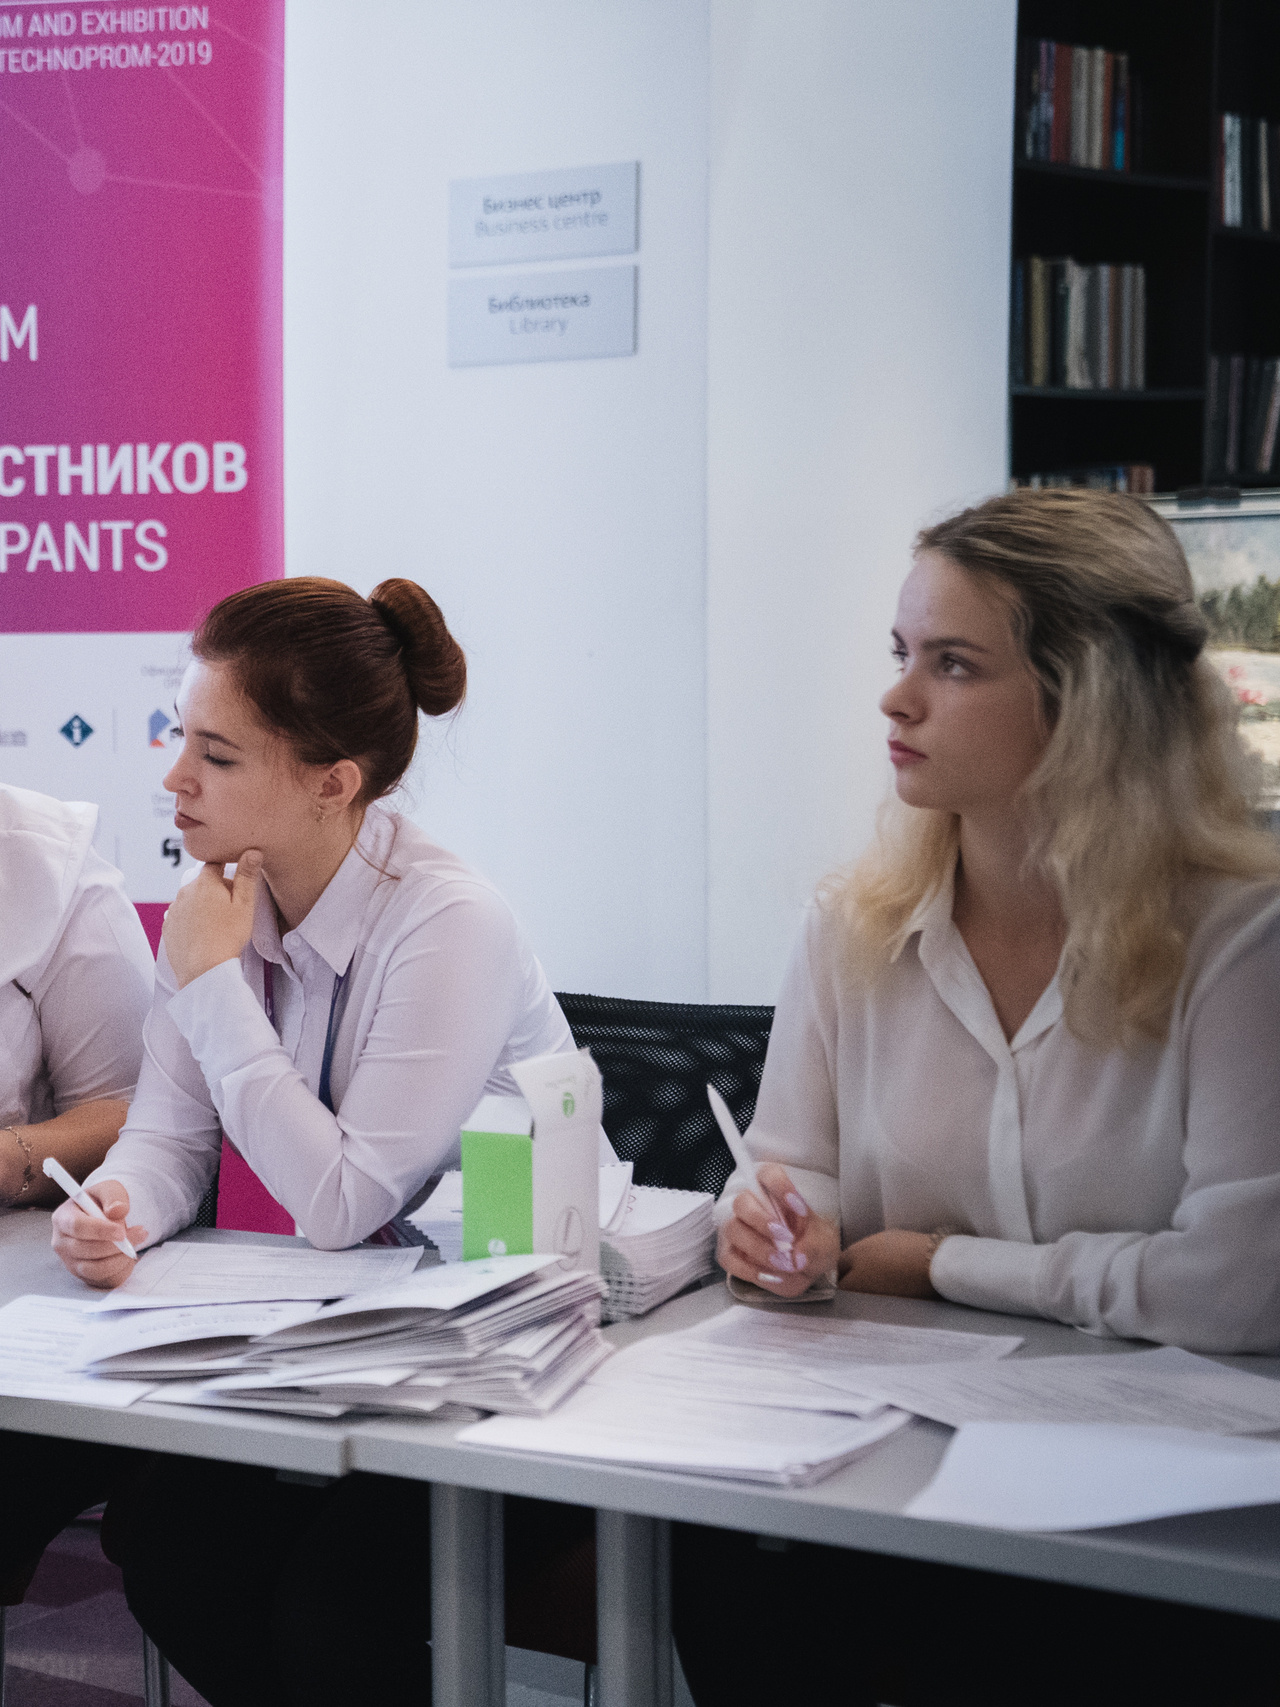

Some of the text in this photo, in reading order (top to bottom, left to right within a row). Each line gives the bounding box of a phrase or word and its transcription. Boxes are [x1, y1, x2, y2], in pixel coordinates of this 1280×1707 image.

[28, 11, 77, 37] AND
[81, 5, 210, 35] EXHIBITION
[482, 189, 603, 215] Бизнес центр
[553, 212, 609, 231] centre
[487, 291, 591, 314] Библиотека
[509, 317, 569, 337] Library
